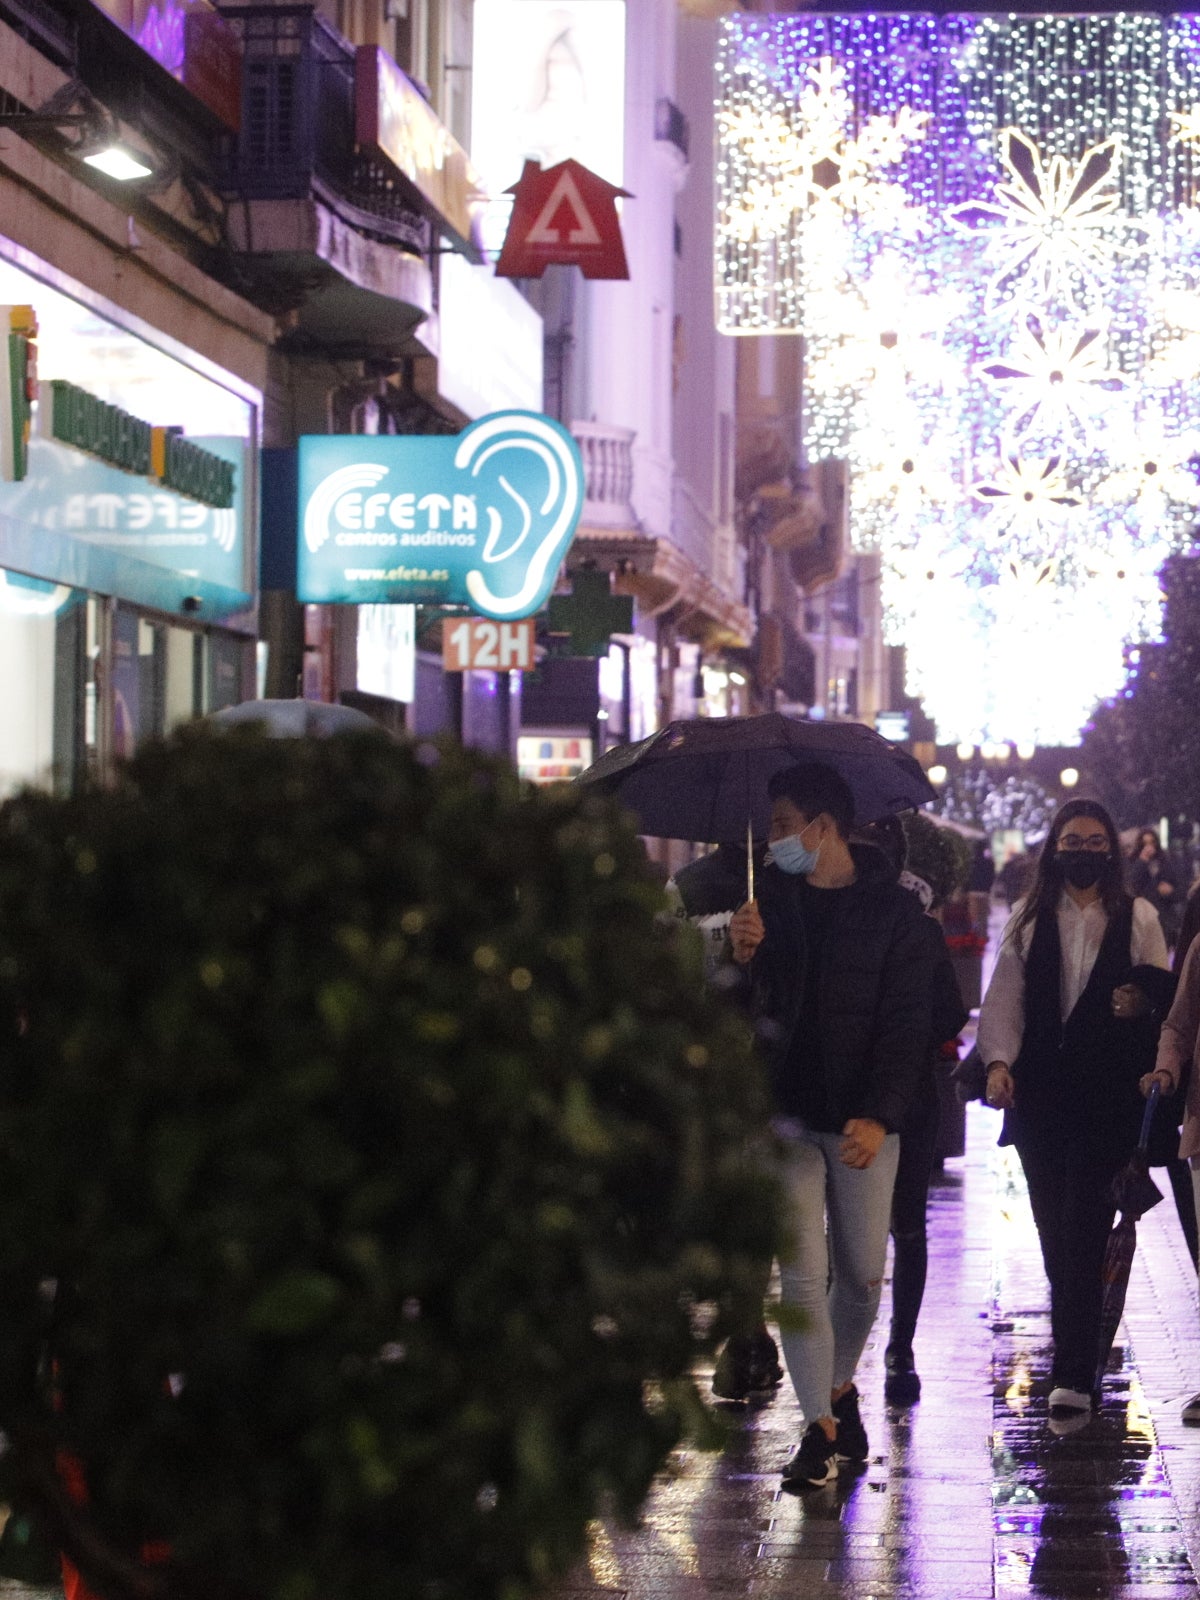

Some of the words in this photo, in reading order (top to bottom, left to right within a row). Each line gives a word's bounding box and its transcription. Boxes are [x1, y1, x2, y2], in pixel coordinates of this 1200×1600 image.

[334, 493, 477, 529] EFETA
[335, 532, 397, 546] centros
[401, 530, 475, 546] auditivos
[344, 566, 448, 581] www.efeta.es
[450, 623, 530, 666] 12H
